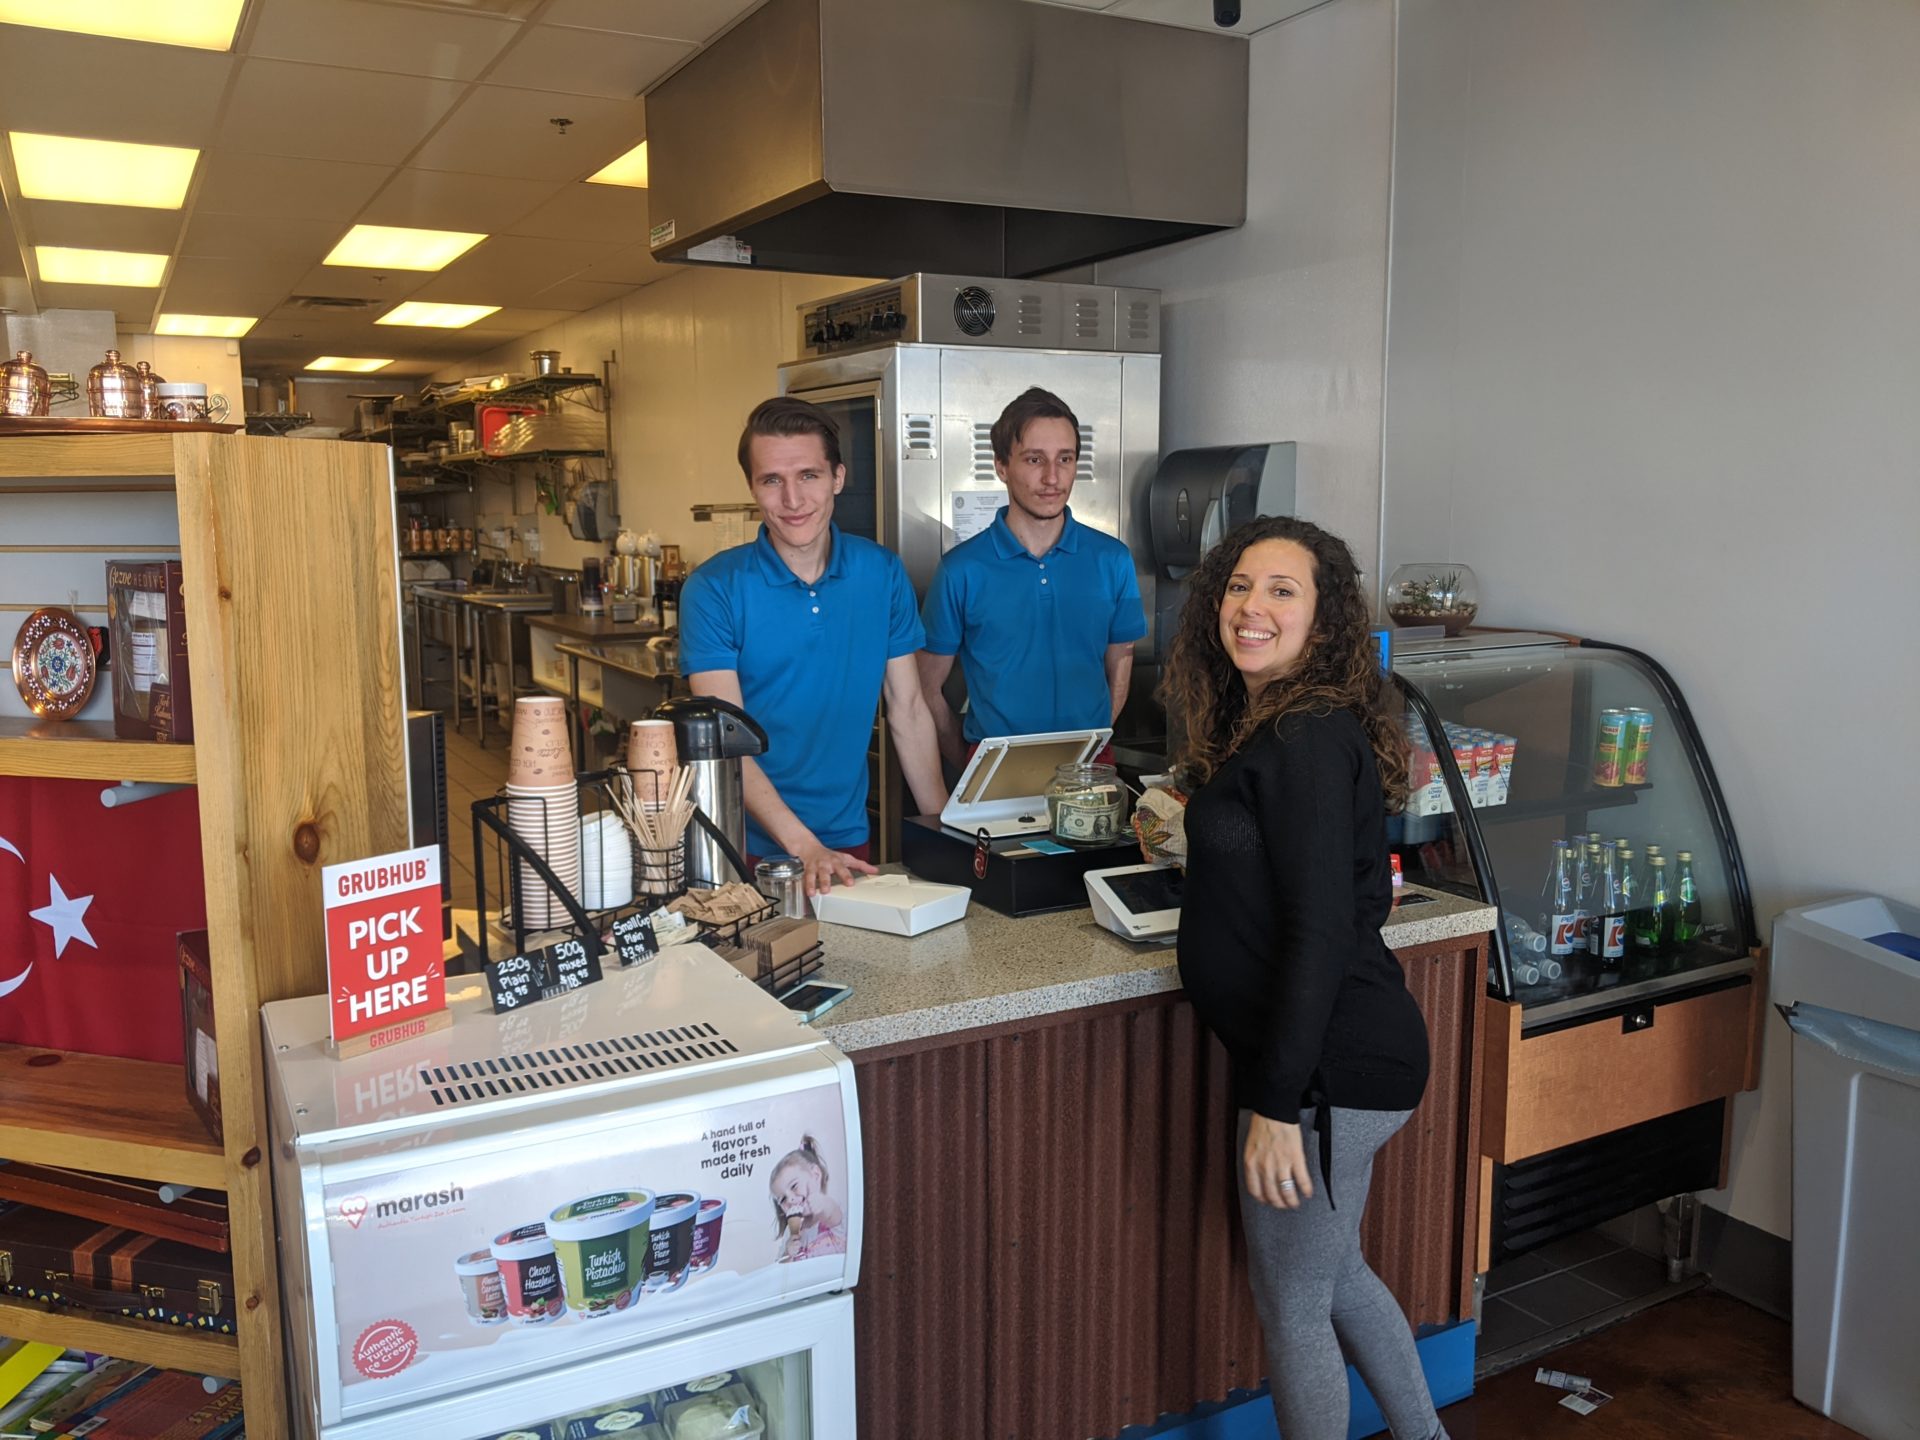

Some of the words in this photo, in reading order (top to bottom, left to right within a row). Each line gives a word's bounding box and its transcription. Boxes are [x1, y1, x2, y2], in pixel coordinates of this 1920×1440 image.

[338, 859, 427, 897] GRUBHUB
[349, 905, 423, 950] PICK
[613, 916, 638, 936] Small
[635, 913, 651, 929] Cup
[623, 931, 645, 945] Plain
[554, 941, 586, 960] 500g
[366, 946, 409, 981] UP
[497, 956, 531, 975] 250g
[558, 958, 587, 972] mixed
[499, 973, 530, 990] Plain
[350, 975, 428, 1024] HERE
[496, 984, 529, 1008] $8.95
[369, 1019, 426, 1048] GRUBHUB
[701, 1131, 708, 1141] A
[710, 1125, 735, 1139] hand
[738, 1121, 753, 1133] full
[755, 1118, 766, 1129] of
[711, 1134, 758, 1153] flavors
[700, 1153, 736, 1169] made
[739, 1144, 771, 1161] fresh
[721, 1163, 753, 1179] daily
[376, 1182, 464, 1218] marash
[588, 1247, 621, 1268] Turkish
[525, 1273, 556, 1290] Hazelnut
[528, 1264, 551, 1278] Choco
[585, 1261, 626, 1281] Pistachio
[358, 1327, 405, 1361] Authentic
[367, 1336, 405, 1363] Turkish
[365, 1361, 381, 1374] Ice
[382, 1339, 416, 1363] Cream
